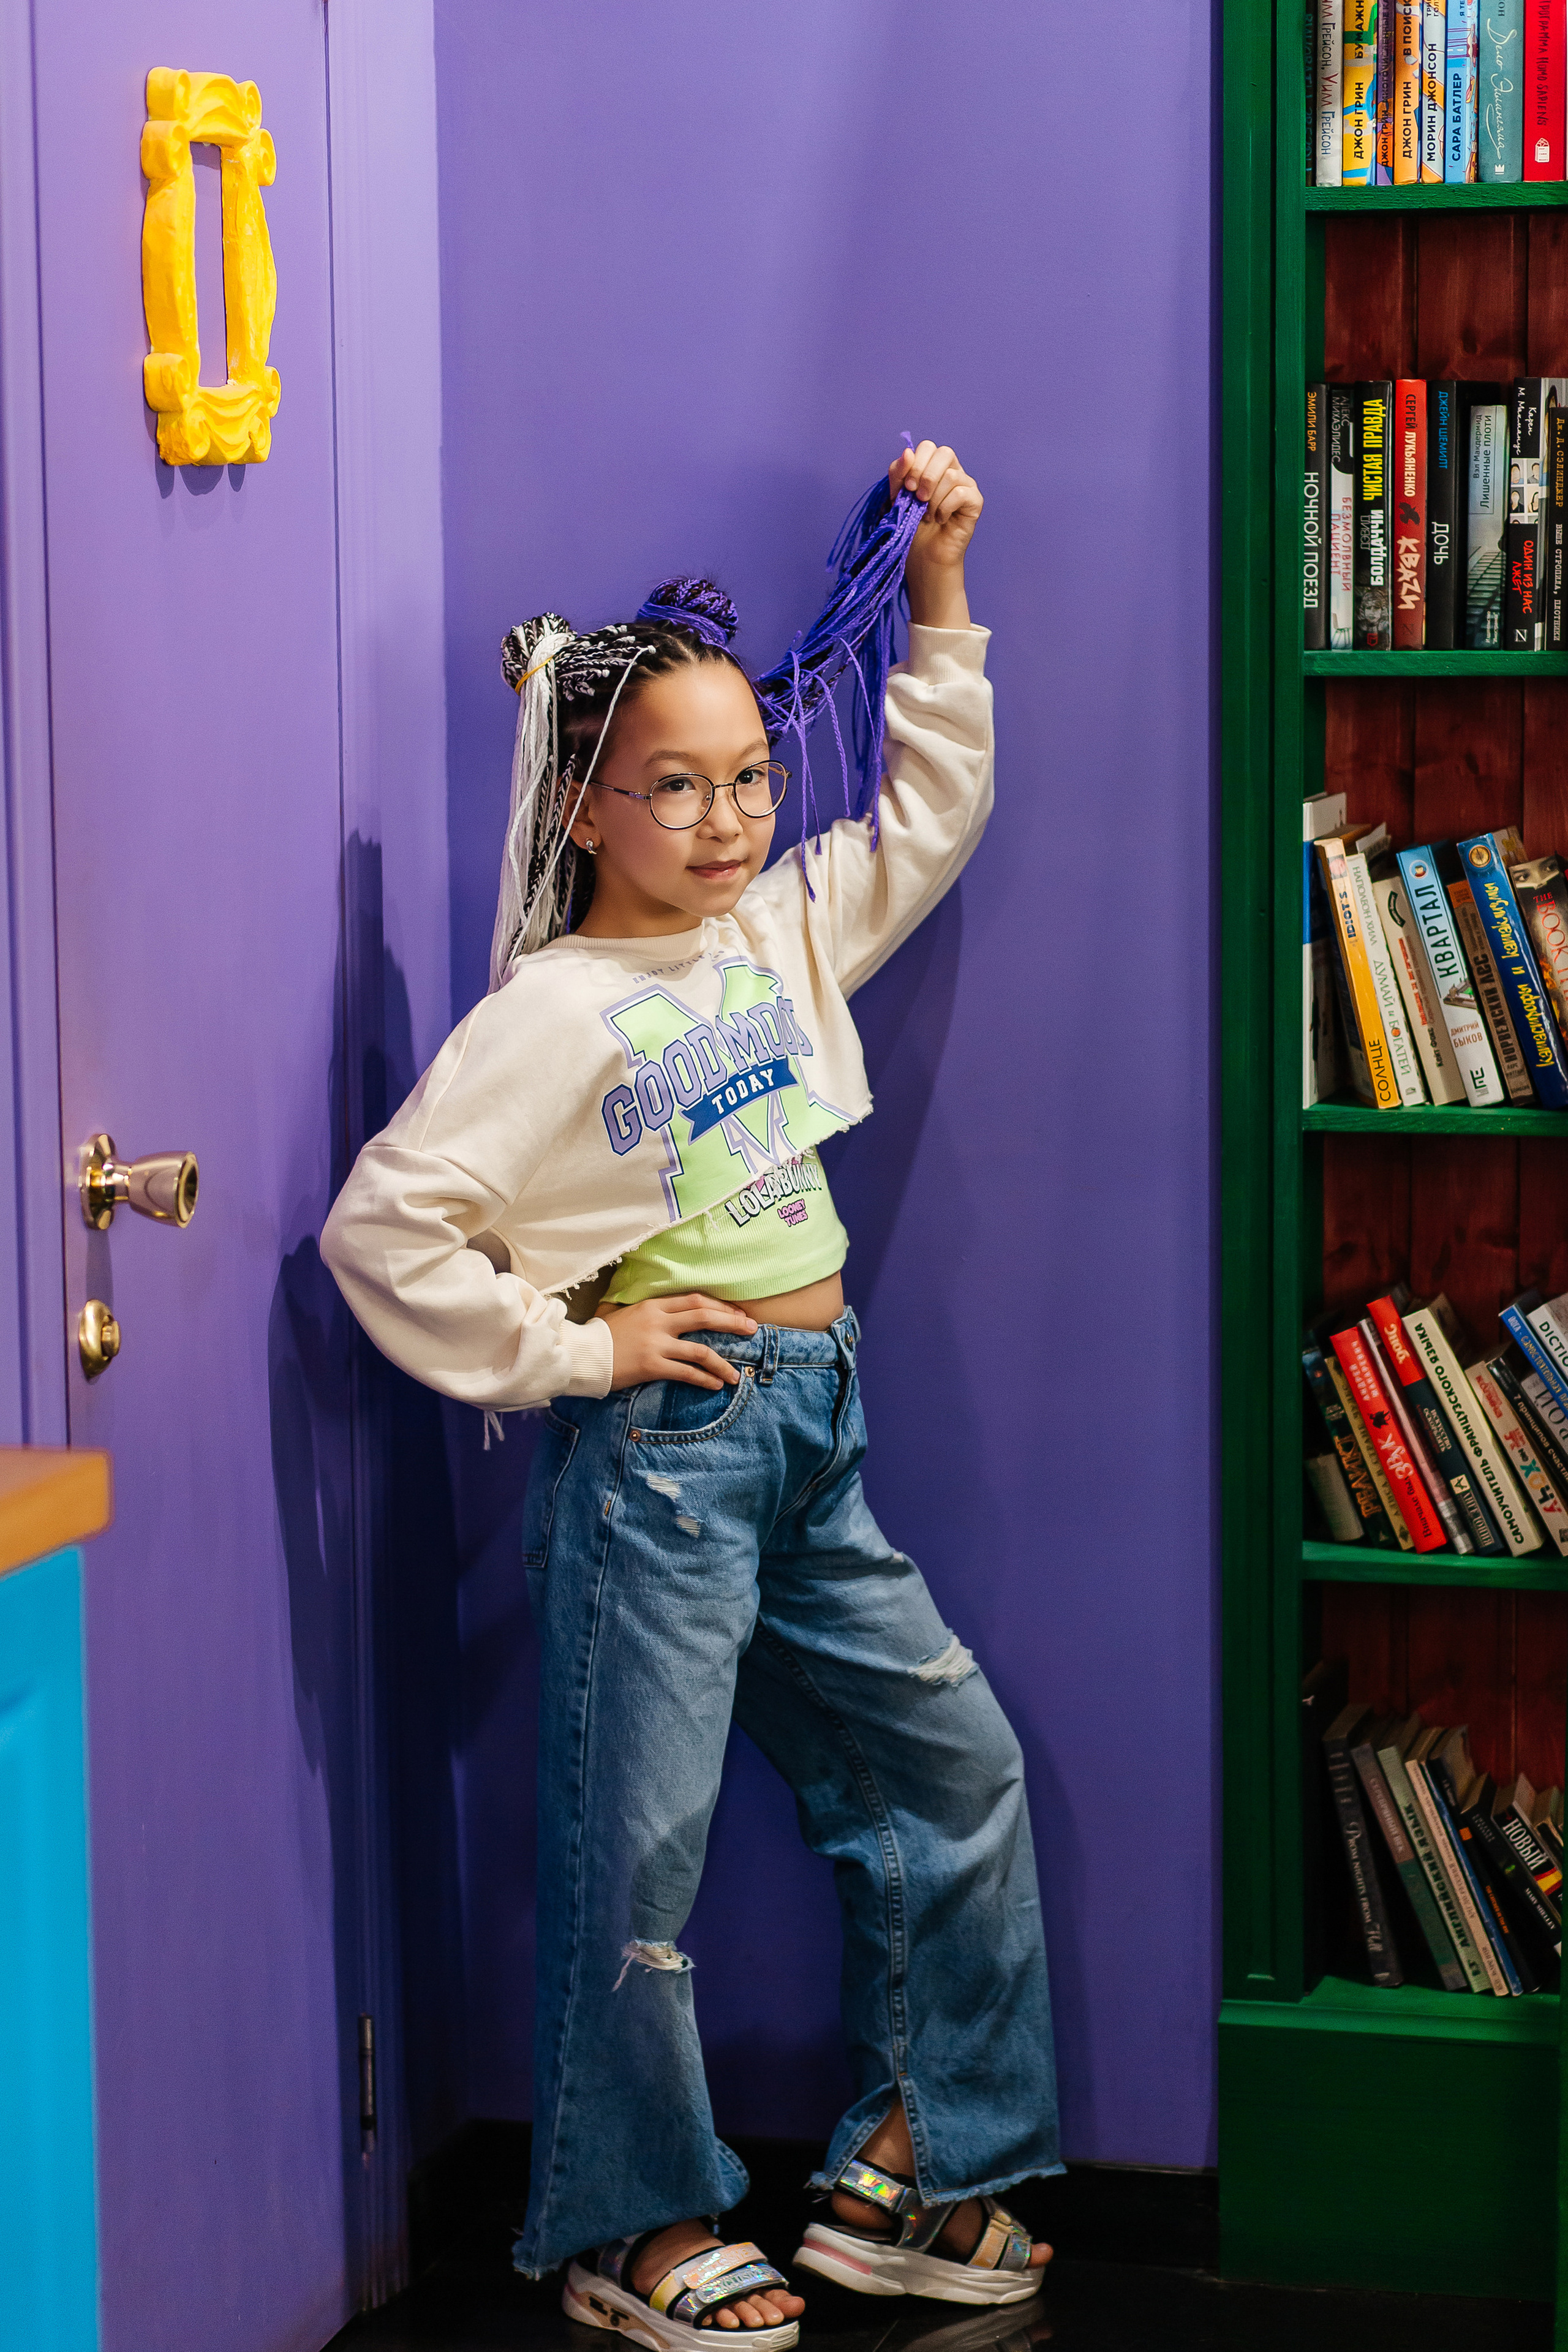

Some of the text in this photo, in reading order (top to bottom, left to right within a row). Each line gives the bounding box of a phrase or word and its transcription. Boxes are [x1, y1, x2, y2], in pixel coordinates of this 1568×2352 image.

[1487, 18, 1518, 71] Дело
[1354, 81, 1365, 114] ГРИН
[1403, 81, 1413, 113] ГРИН
[1427, 43, 1438, 162] МОРИН ДЖОНСОН
[1452, 72, 1463, 162] САРА БАТЛЕР
[1354, 115, 1365, 159] ДЖОН
[1381, 137, 1390, 167] ДЖОН
[1403, 117, 1413, 159] ДЖОН
[1307, 391, 1317, 452] ЭМИЛИ БАРР
[1331, 397, 1341, 462] МИХАЭЛИДЕС
[1363, 399, 1386, 501] ЧИСТАЯ ПРАВДА
[1404, 394, 1417, 497] СЕРГЕЙ ЛУКЬЯНЕНКО
[1438, 391, 1450, 469] ДЖЕЙН ШЕМИЛТ
[1474, 414, 1483, 462] Макдермид
[1513, 386, 1526, 456] М. Макманус
[1525, 407, 1537, 436] Карен
[1480, 415, 1492, 509] Лишенные плоти
[1555, 450, 1564, 508] СЭЛИНДЖЕР
[1303, 472, 1322, 609] НОЧНОЙ ПОЕЗД
[1330, 513, 1341, 576] ПАЦИЕНТ
[1341, 497, 1352, 592] БЕЗМОЛВНЫЙ
[1360, 515, 1371, 551] ДЭВИД
[1370, 510, 1387, 586] БОЛДАЧЧИ
[1431, 522, 1450, 565] ДОЧЬ
[1512, 561, 1523, 595] ЛЖЕТ
[1522, 540, 1534, 614] ОДИН ИЗ НАС
[1351, 865, 1378, 947] НАПОЛЕОН ХИЛЛ
[1532, 891, 1554, 905] THE
[1414, 884, 1460, 980] КВАРТАЛ
[1536, 900, 1568, 963] BOOK
[632, 967, 665, 985] ENJOY
[1373, 959, 1395, 1008] ДУМАЙ
[1450, 1020, 1480, 1038] ДМИТРИЙ
[1453, 1031, 1484, 1049] БЫКОВ
[1490, 985, 1520, 1063] НОРВЕЖСКИЙ
[601, 1022, 728, 1157] GOOD
[711, 1068, 774, 1115] TODAY
[1368, 1038, 1391, 1102] СОЛНЦЕ
[777, 1198, 807, 1219] LOONEY
[783, 1209, 809, 1227] TUNES
[1350, 1340, 1381, 1398] МАКАРЕВИЧ
[1412, 1322, 1442, 1365] ЯЗЫКА
[1349, 1363, 1371, 1402] АНДРЕЙ
[1430, 1363, 1489, 1459] ФРАНЦУЗСКОГО
[1429, 1409, 1453, 1450] ИСКУССТВО
[1332, 1430, 1384, 1518] РЕЛИКТ
[1474, 1457, 1530, 1545] САМОУЧИТЕЛЬ
[1402, 1803, 1430, 1849] ЯЗЫК
[1501, 1814, 1550, 1873] НОВЫЙ
[1359, 1896, 1373, 1923] FROM
[1420, 1850, 1471, 1950] АНГЛИЙСКИЙ
